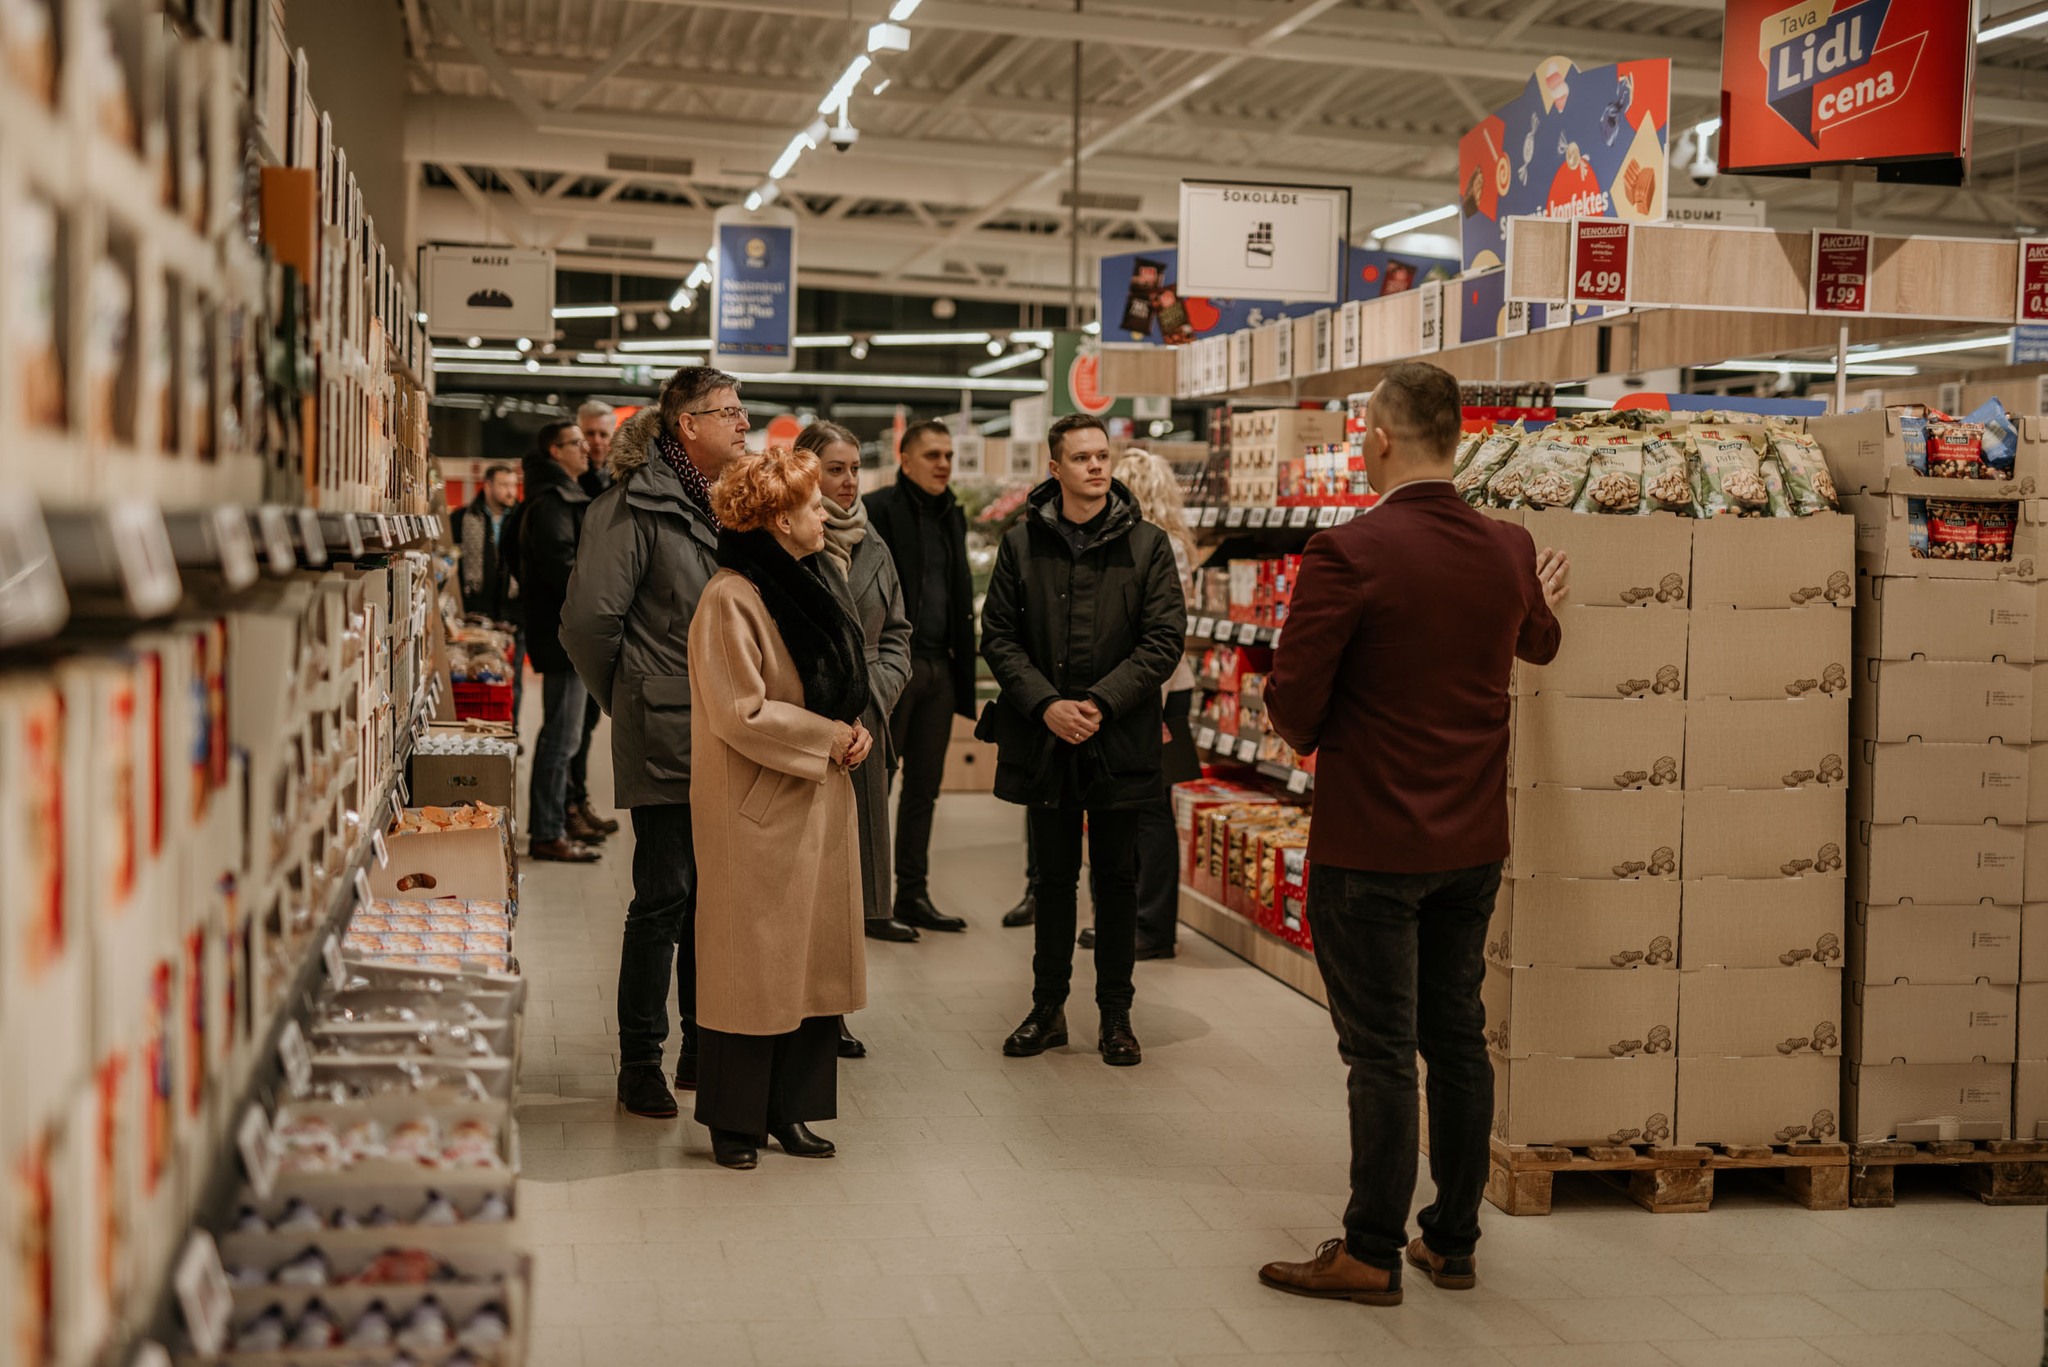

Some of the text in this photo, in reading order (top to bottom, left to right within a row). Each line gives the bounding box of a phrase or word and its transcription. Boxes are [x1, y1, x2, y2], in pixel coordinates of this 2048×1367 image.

[1780, 10, 1817, 36] Tava
[1778, 15, 1863, 91] Lidl
[1817, 71, 1895, 121] cena
[1550, 190, 1609, 219] konfektes
[1667, 209, 1722, 221] ALDUMI
[1580, 225, 1627, 238] NENOKAVĒ!
[1822, 236, 1866, 250] AKCIJA!
[472, 256, 510, 266] MAIZE
[1578, 271, 1621, 293] 4.99
[1826, 287, 1857, 304] 1.99
